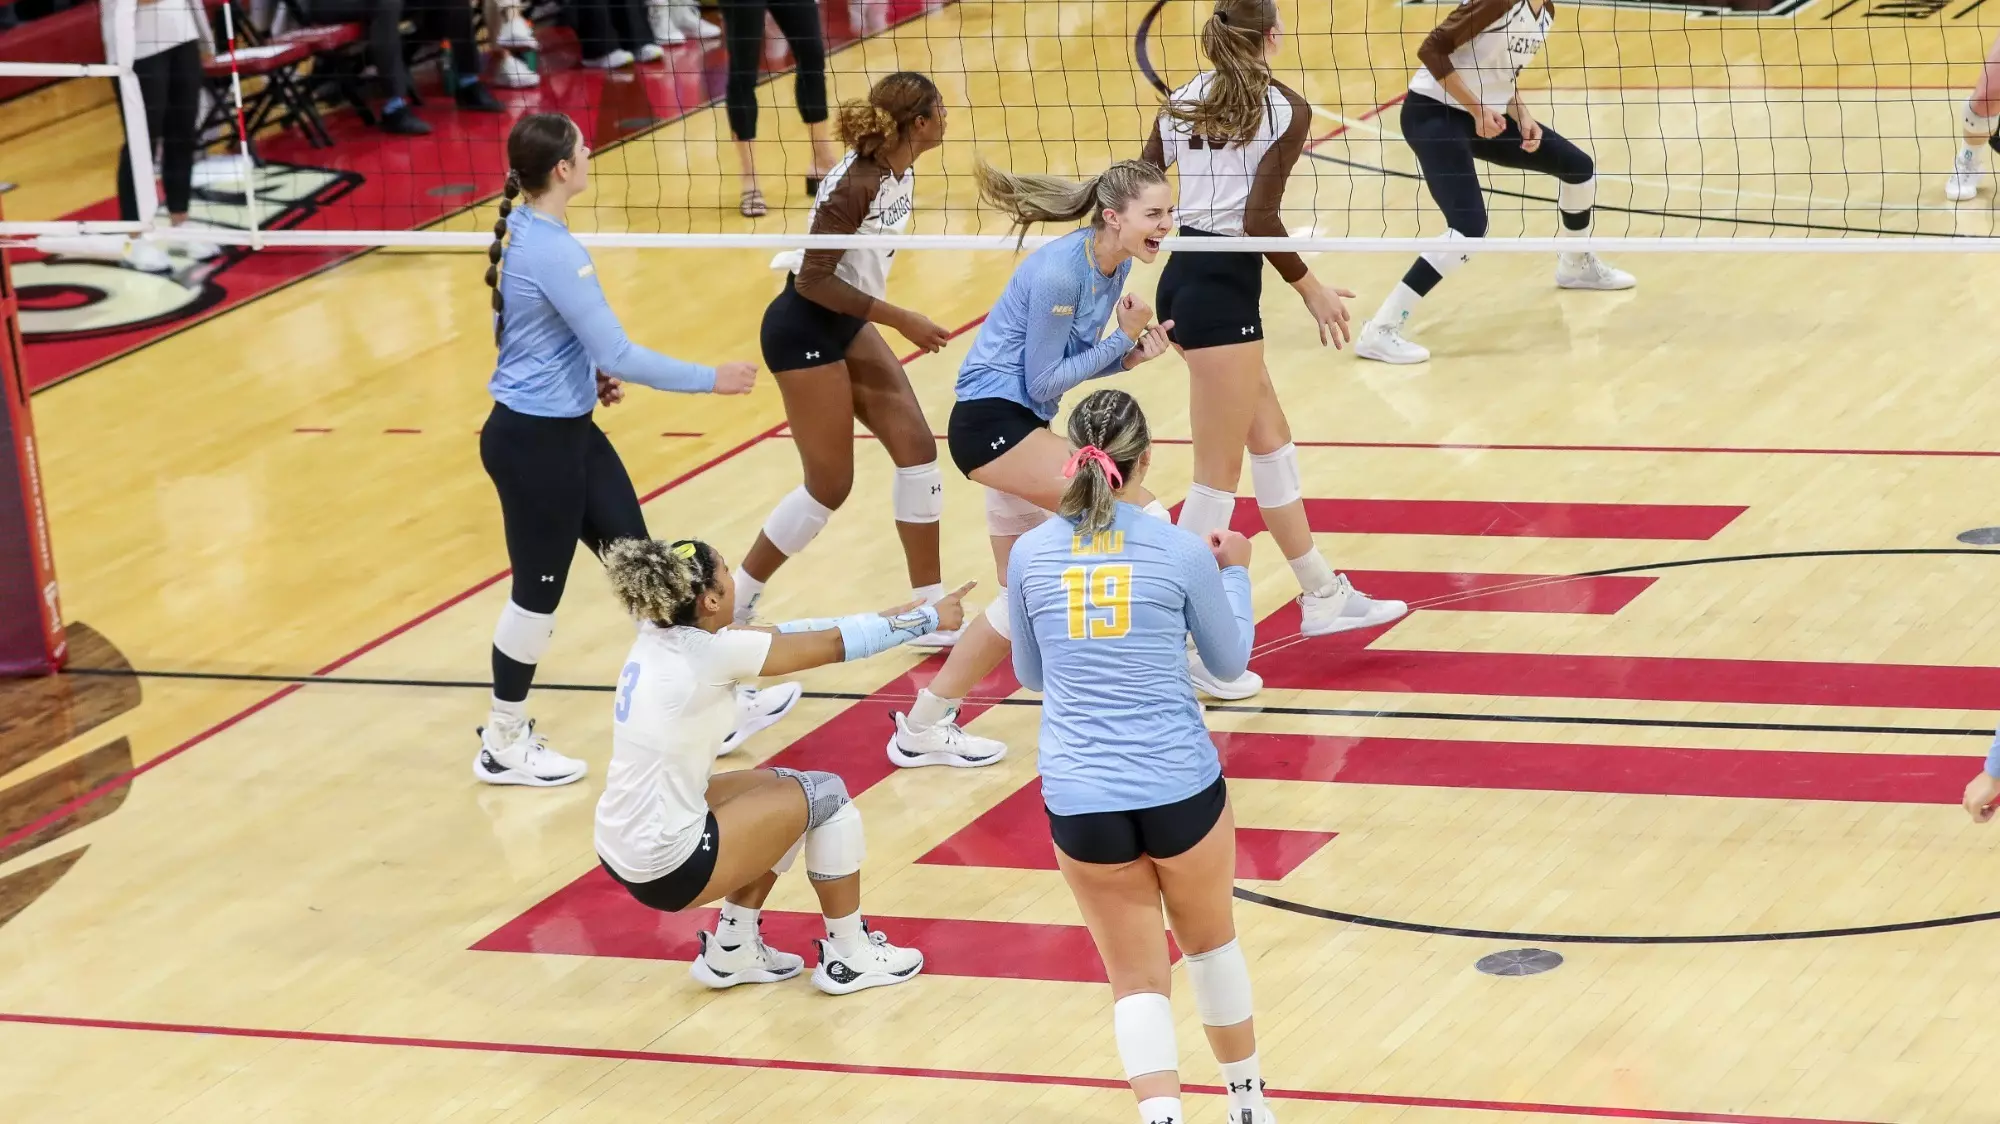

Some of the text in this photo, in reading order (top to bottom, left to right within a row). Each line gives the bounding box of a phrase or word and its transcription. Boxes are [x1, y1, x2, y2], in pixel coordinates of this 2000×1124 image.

[1071, 529, 1124, 555] LIU
[1060, 564, 1132, 640] 19
[615, 661, 641, 723] 3
